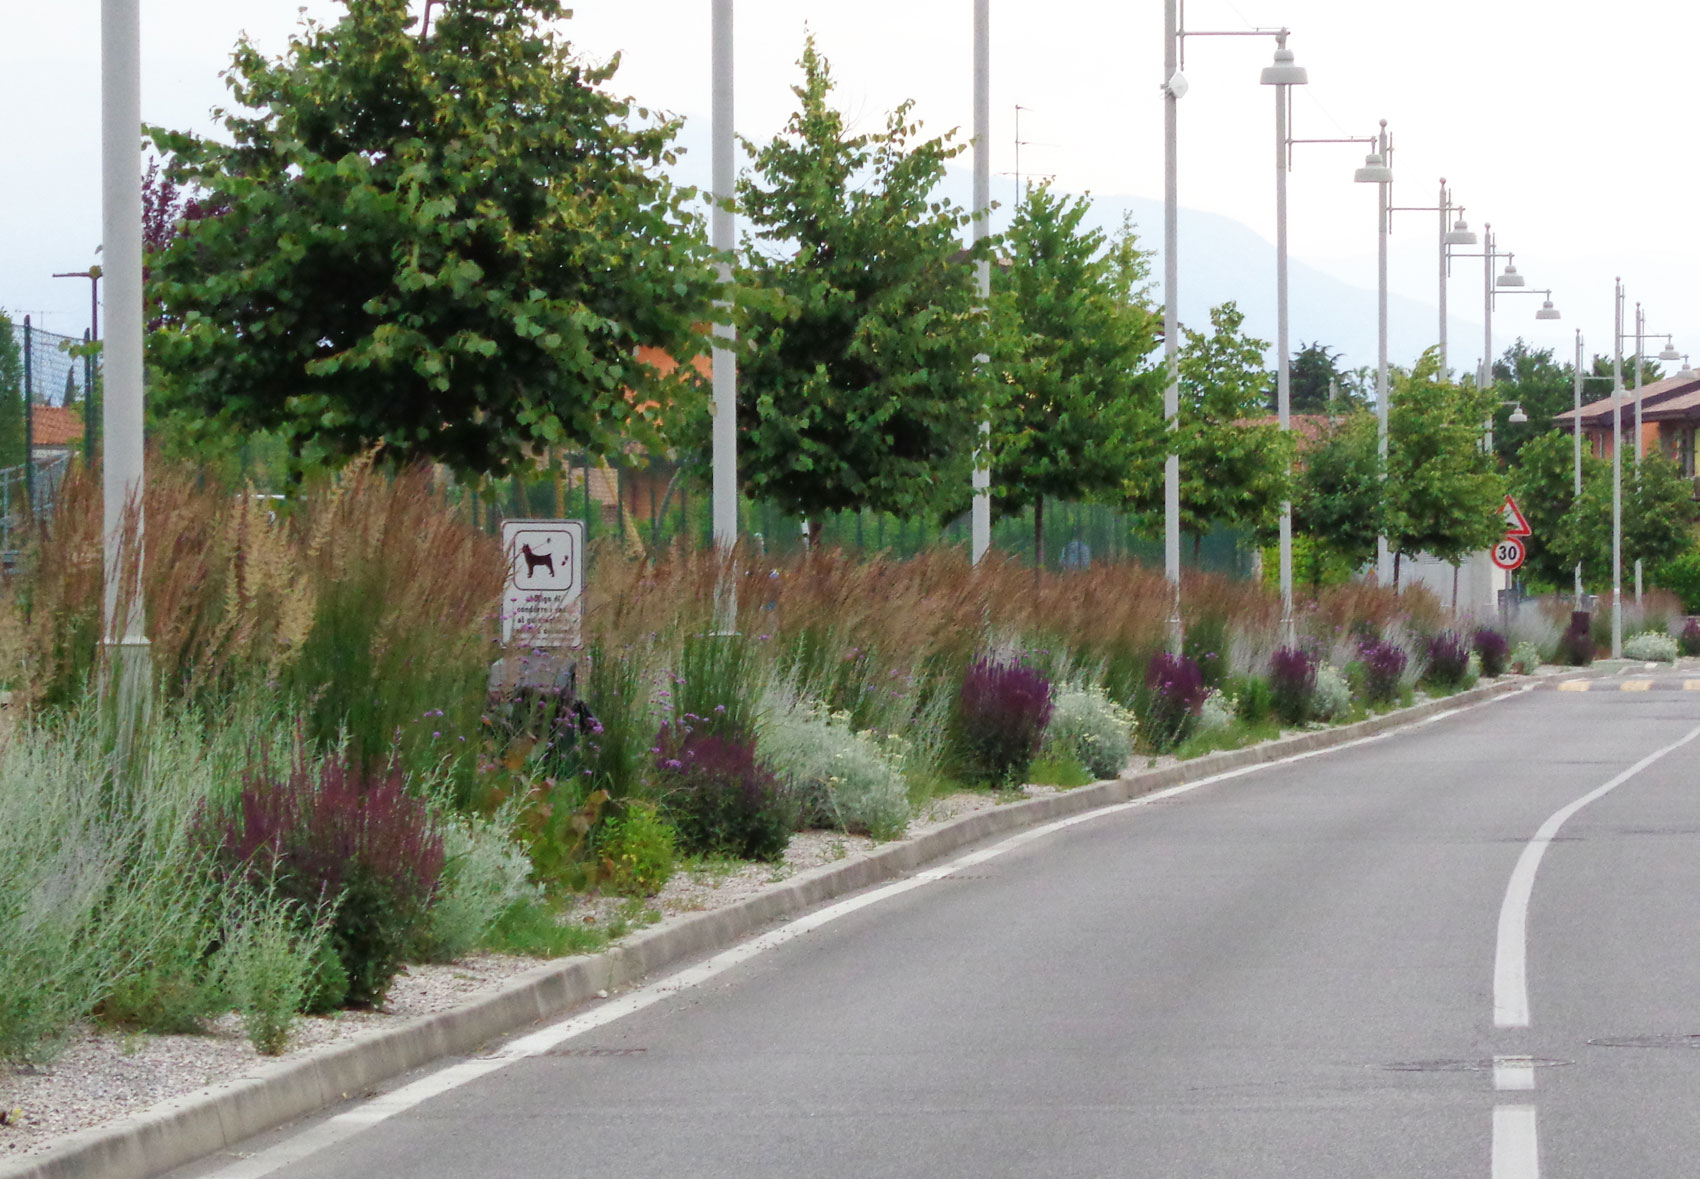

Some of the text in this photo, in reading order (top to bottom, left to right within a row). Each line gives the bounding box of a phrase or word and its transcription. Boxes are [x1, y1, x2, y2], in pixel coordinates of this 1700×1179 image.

[1498, 545, 1517, 560] 30
[554, 594, 562, 602] di
[517, 615, 525, 624] al
